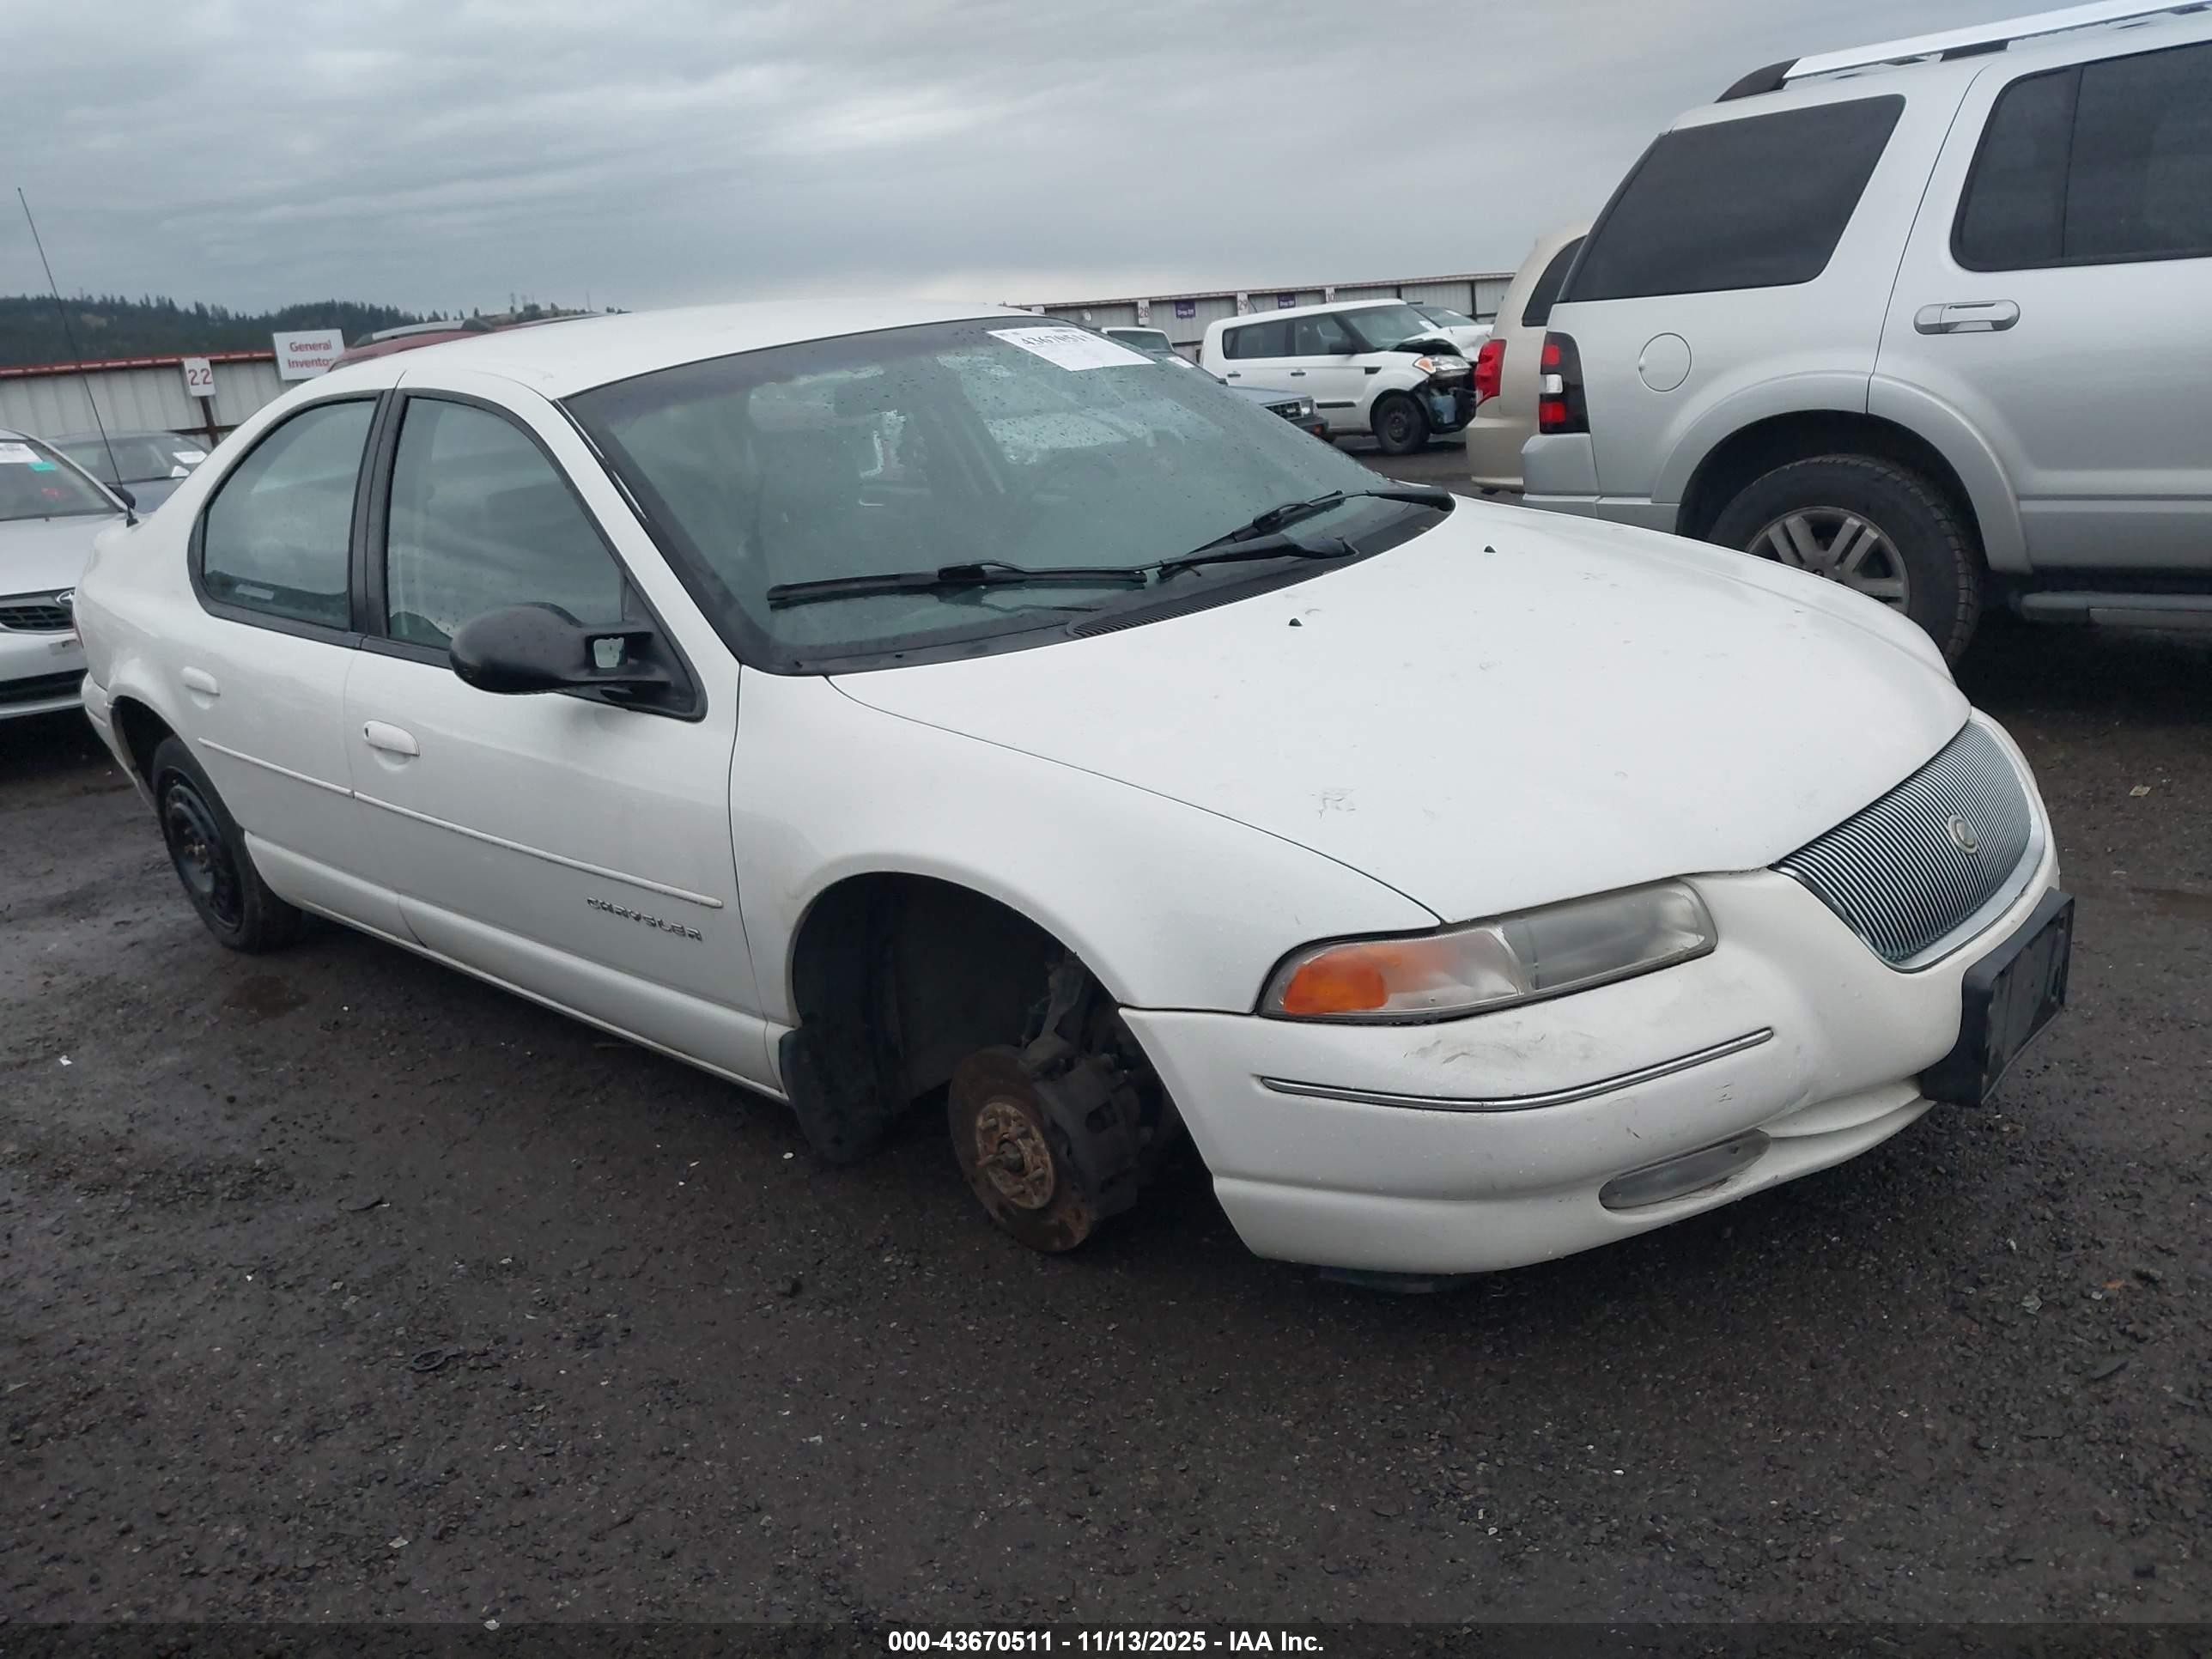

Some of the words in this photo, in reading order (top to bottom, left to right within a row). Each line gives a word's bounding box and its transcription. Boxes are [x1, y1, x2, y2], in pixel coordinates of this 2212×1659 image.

[1139, 307, 1149, 318] 28
[289, 339, 332, 352] General
[187, 368, 213, 386] 22
[586, 896, 702, 942] CHRYSLER
